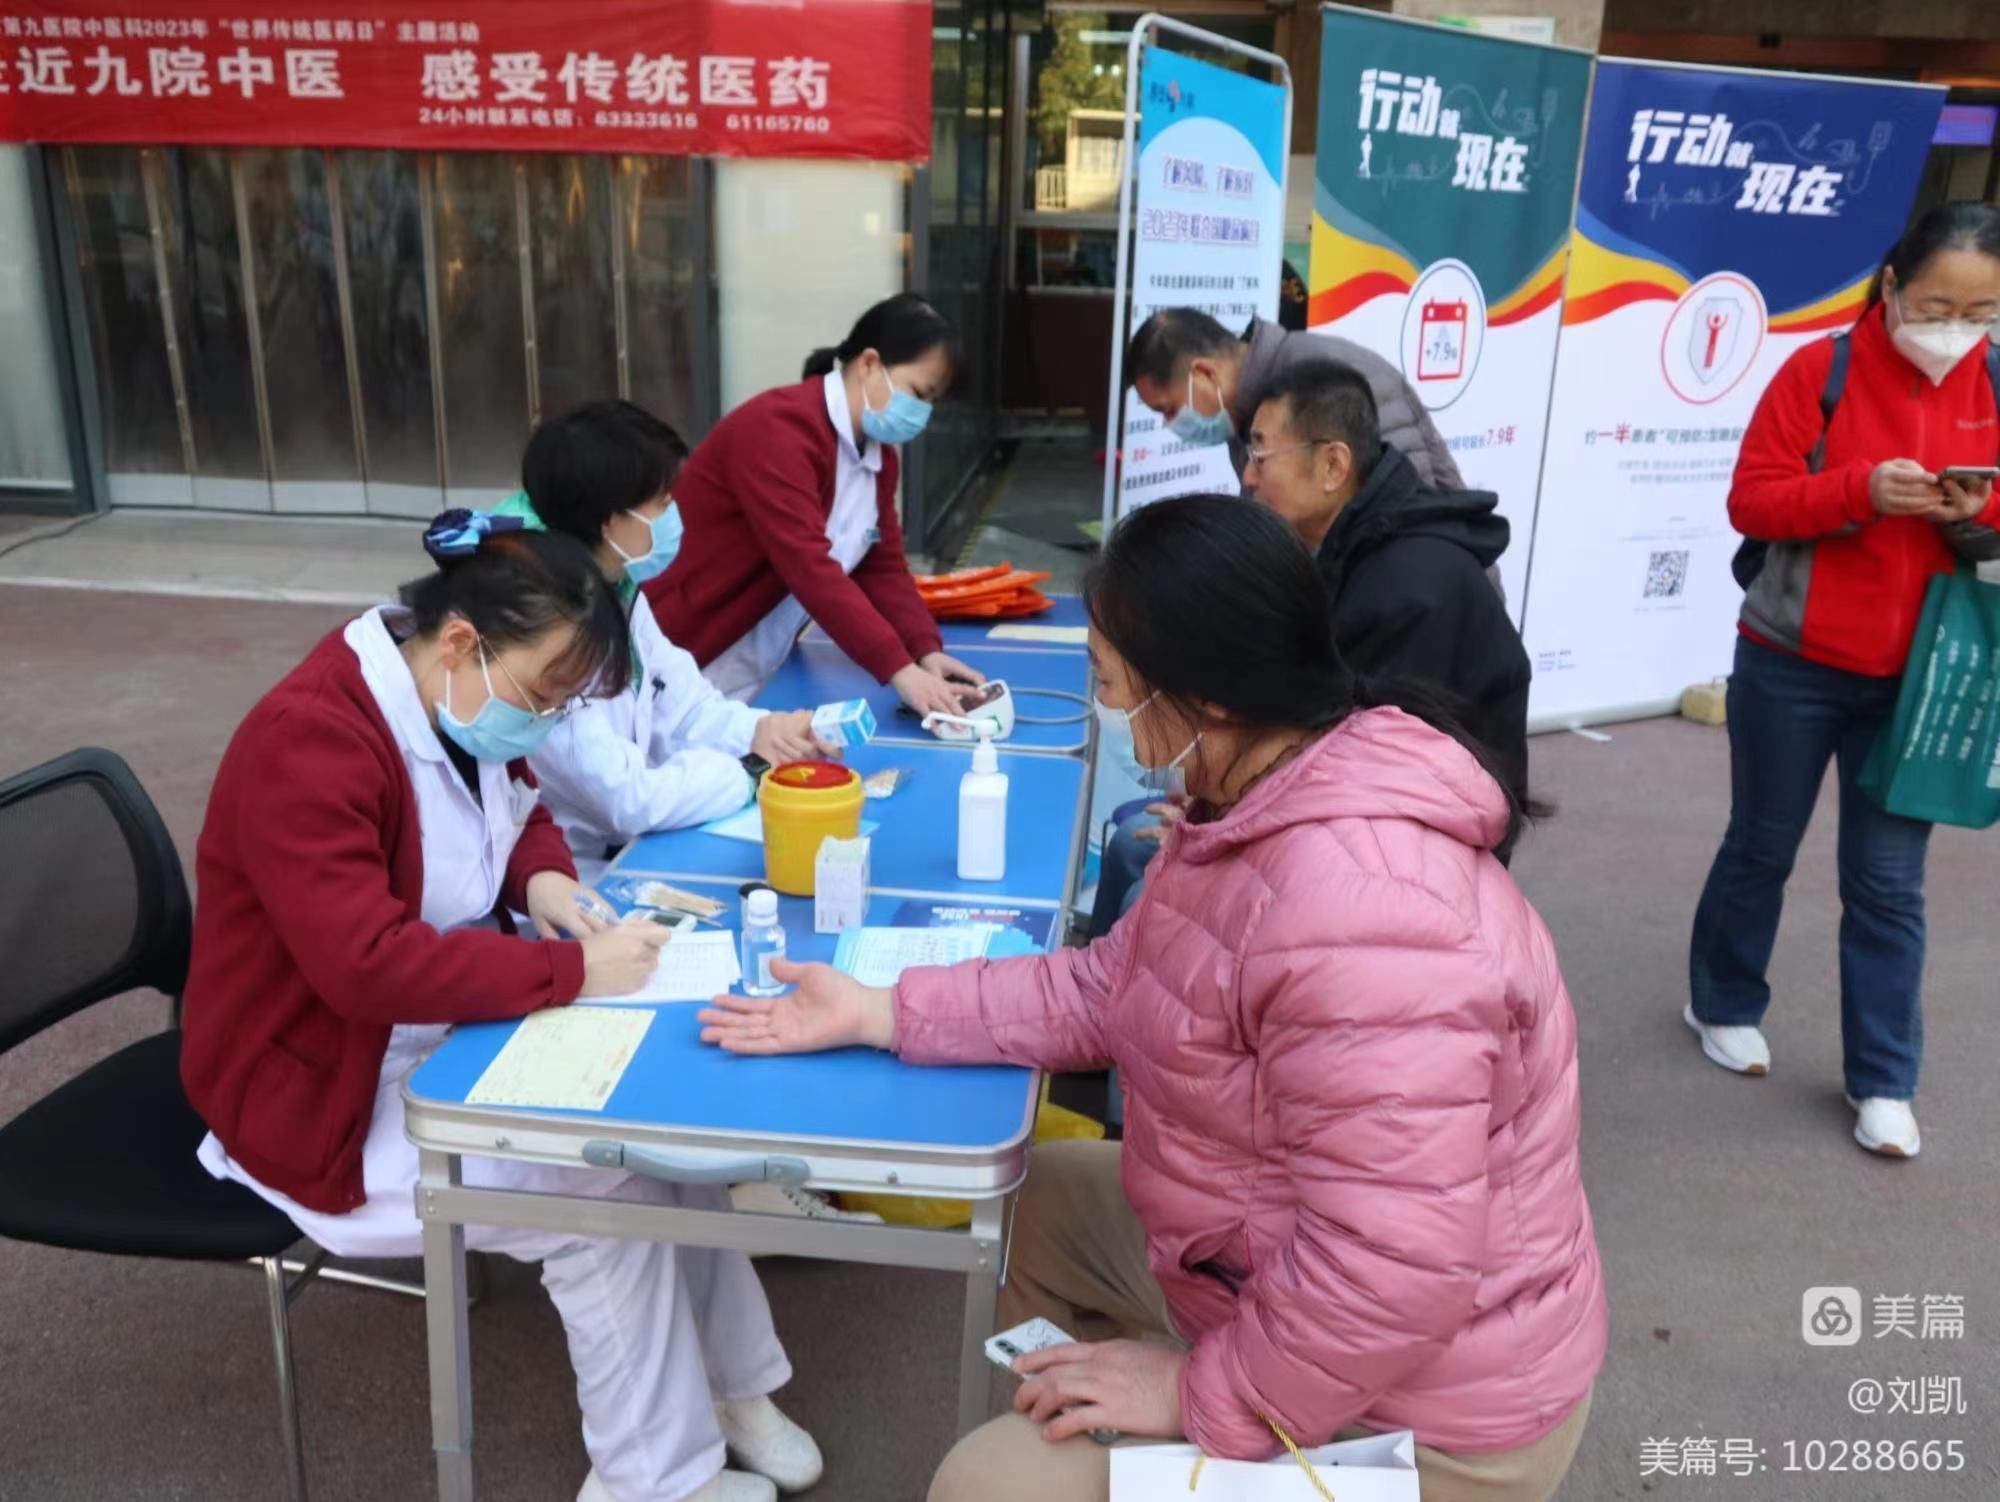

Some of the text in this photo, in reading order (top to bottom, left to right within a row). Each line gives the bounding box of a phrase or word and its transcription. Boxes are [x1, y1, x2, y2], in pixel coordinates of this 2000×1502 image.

[0, 15, 208, 39] 第九医院中医科2023年
[0, 45, 831, 109] 近九院中医 感受传统医药
[726, 113, 831, 133] 61165760
[1452, 132, 1529, 192] 现在
[1735, 162, 1843, 217] 现在
